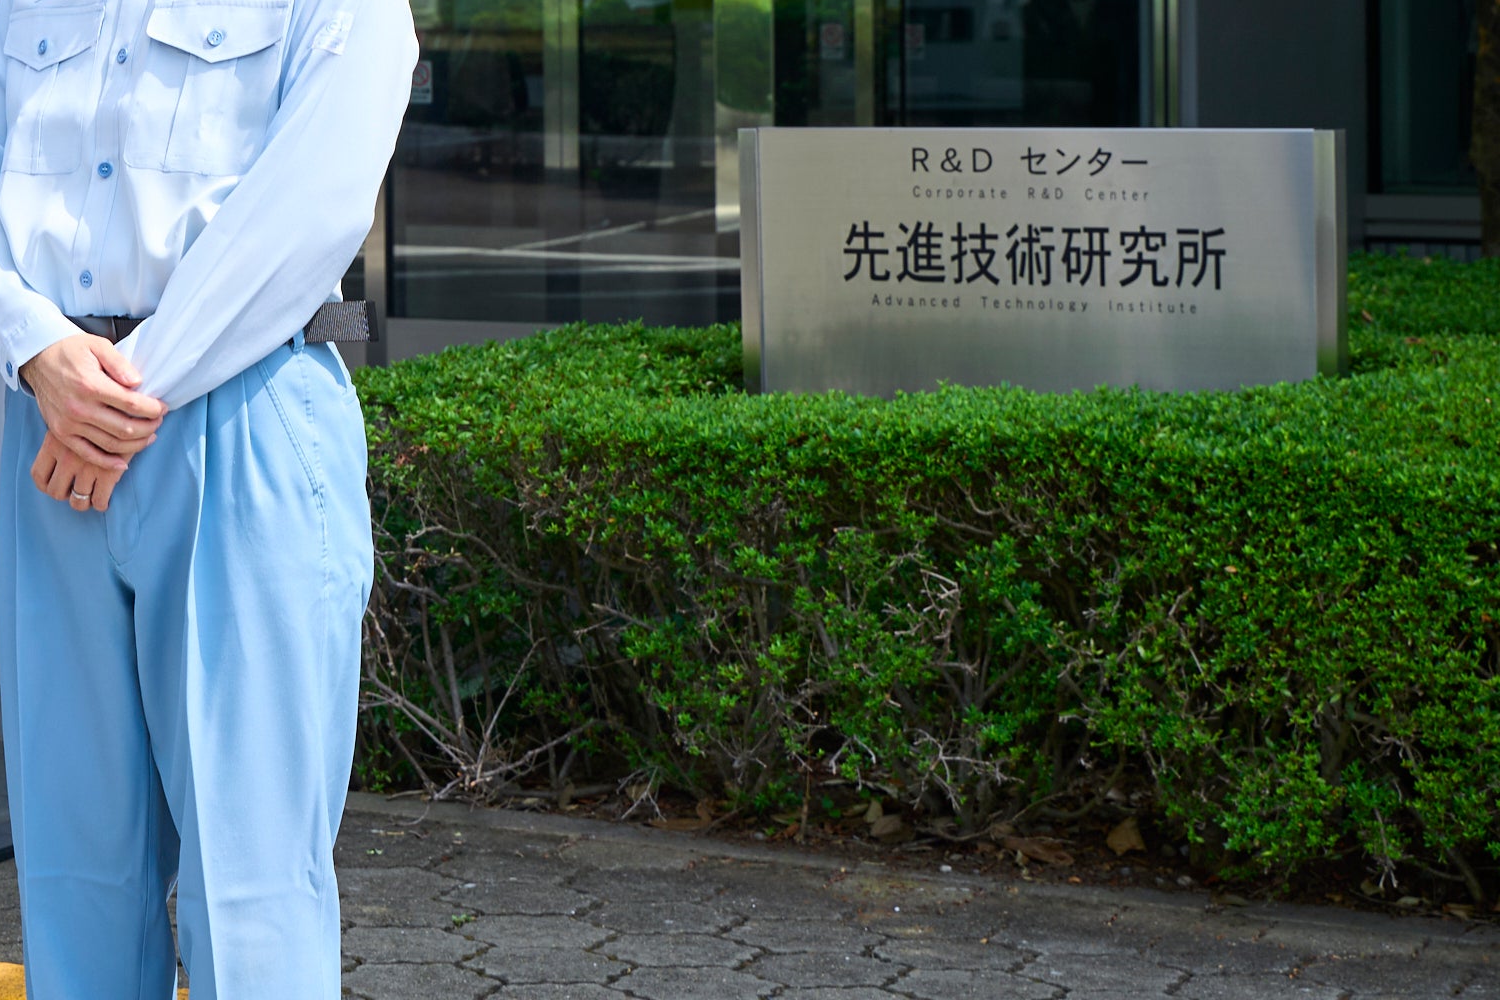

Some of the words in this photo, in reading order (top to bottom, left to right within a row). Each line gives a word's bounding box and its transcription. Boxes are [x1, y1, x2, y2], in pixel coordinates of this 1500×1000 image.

[911, 147, 993, 173] R&D
[1020, 146, 1148, 176] センター
[912, 185, 1007, 199] Corporate
[1027, 187, 1064, 200] R&D
[1084, 188, 1149, 201] Center
[843, 221, 1227, 290] 先進技術研究所
[871, 293, 961, 309] Advanced
[980, 295, 1088, 313] Technology
[1107, 300, 1197, 315] Institute
